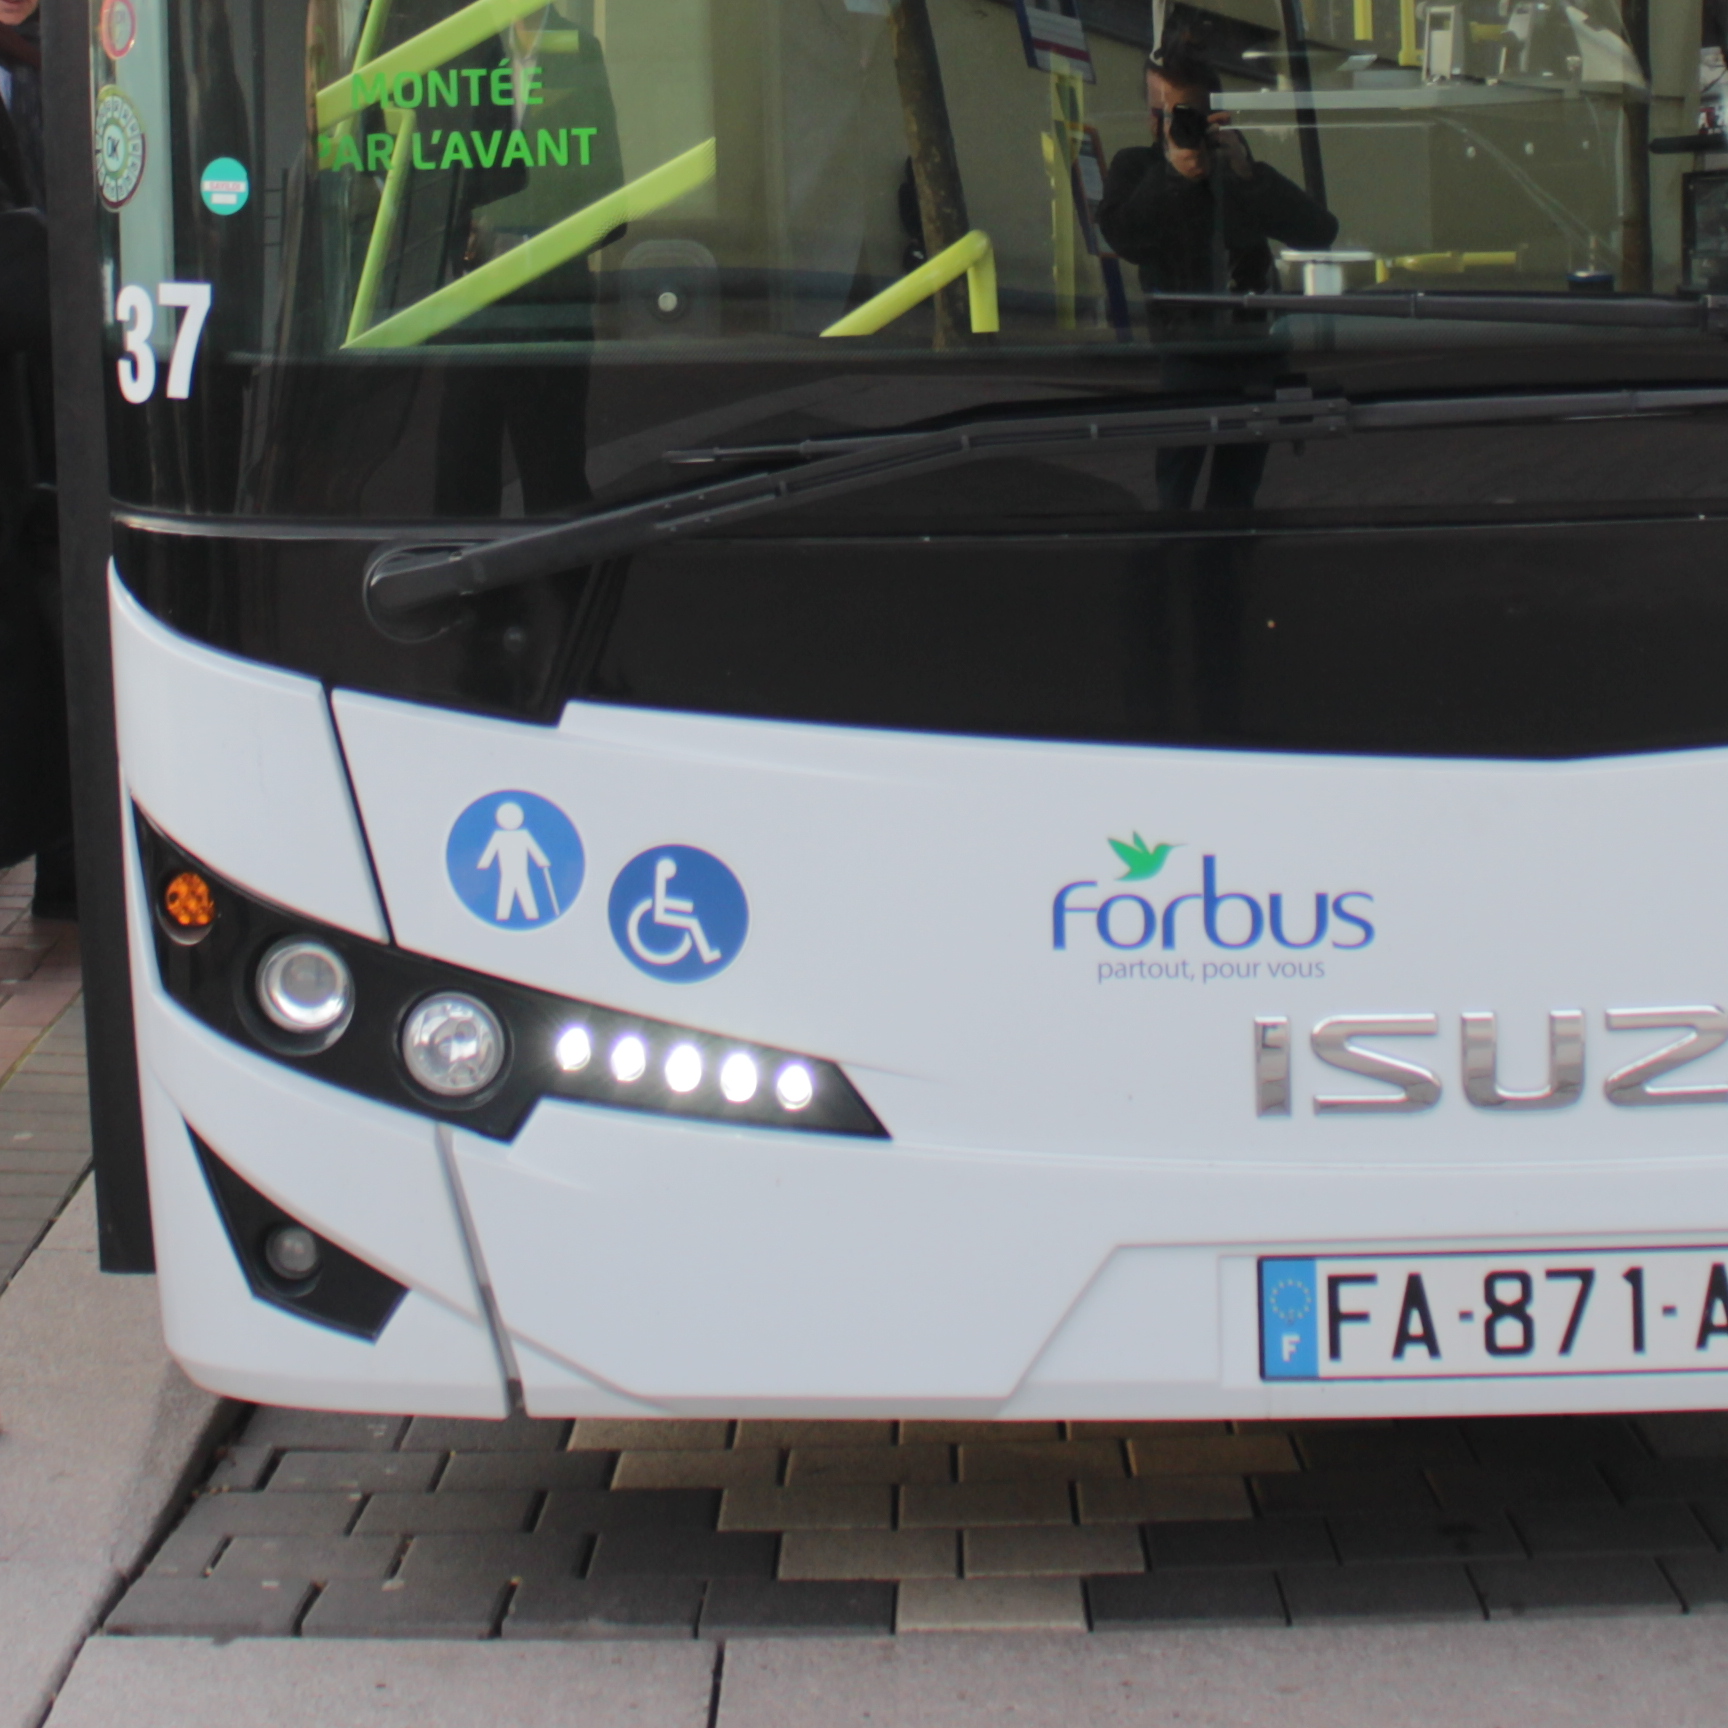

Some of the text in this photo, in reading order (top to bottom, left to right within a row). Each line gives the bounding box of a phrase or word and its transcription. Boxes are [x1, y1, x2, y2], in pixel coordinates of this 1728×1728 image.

[351, 58, 544, 110] MONTÉE
[412, 127, 598, 171] L'AVANT
[115, 281, 212, 405] 37
[1097, 960, 1326, 984] partout, pour vous
[1281, 1333, 1301, 1362] F
